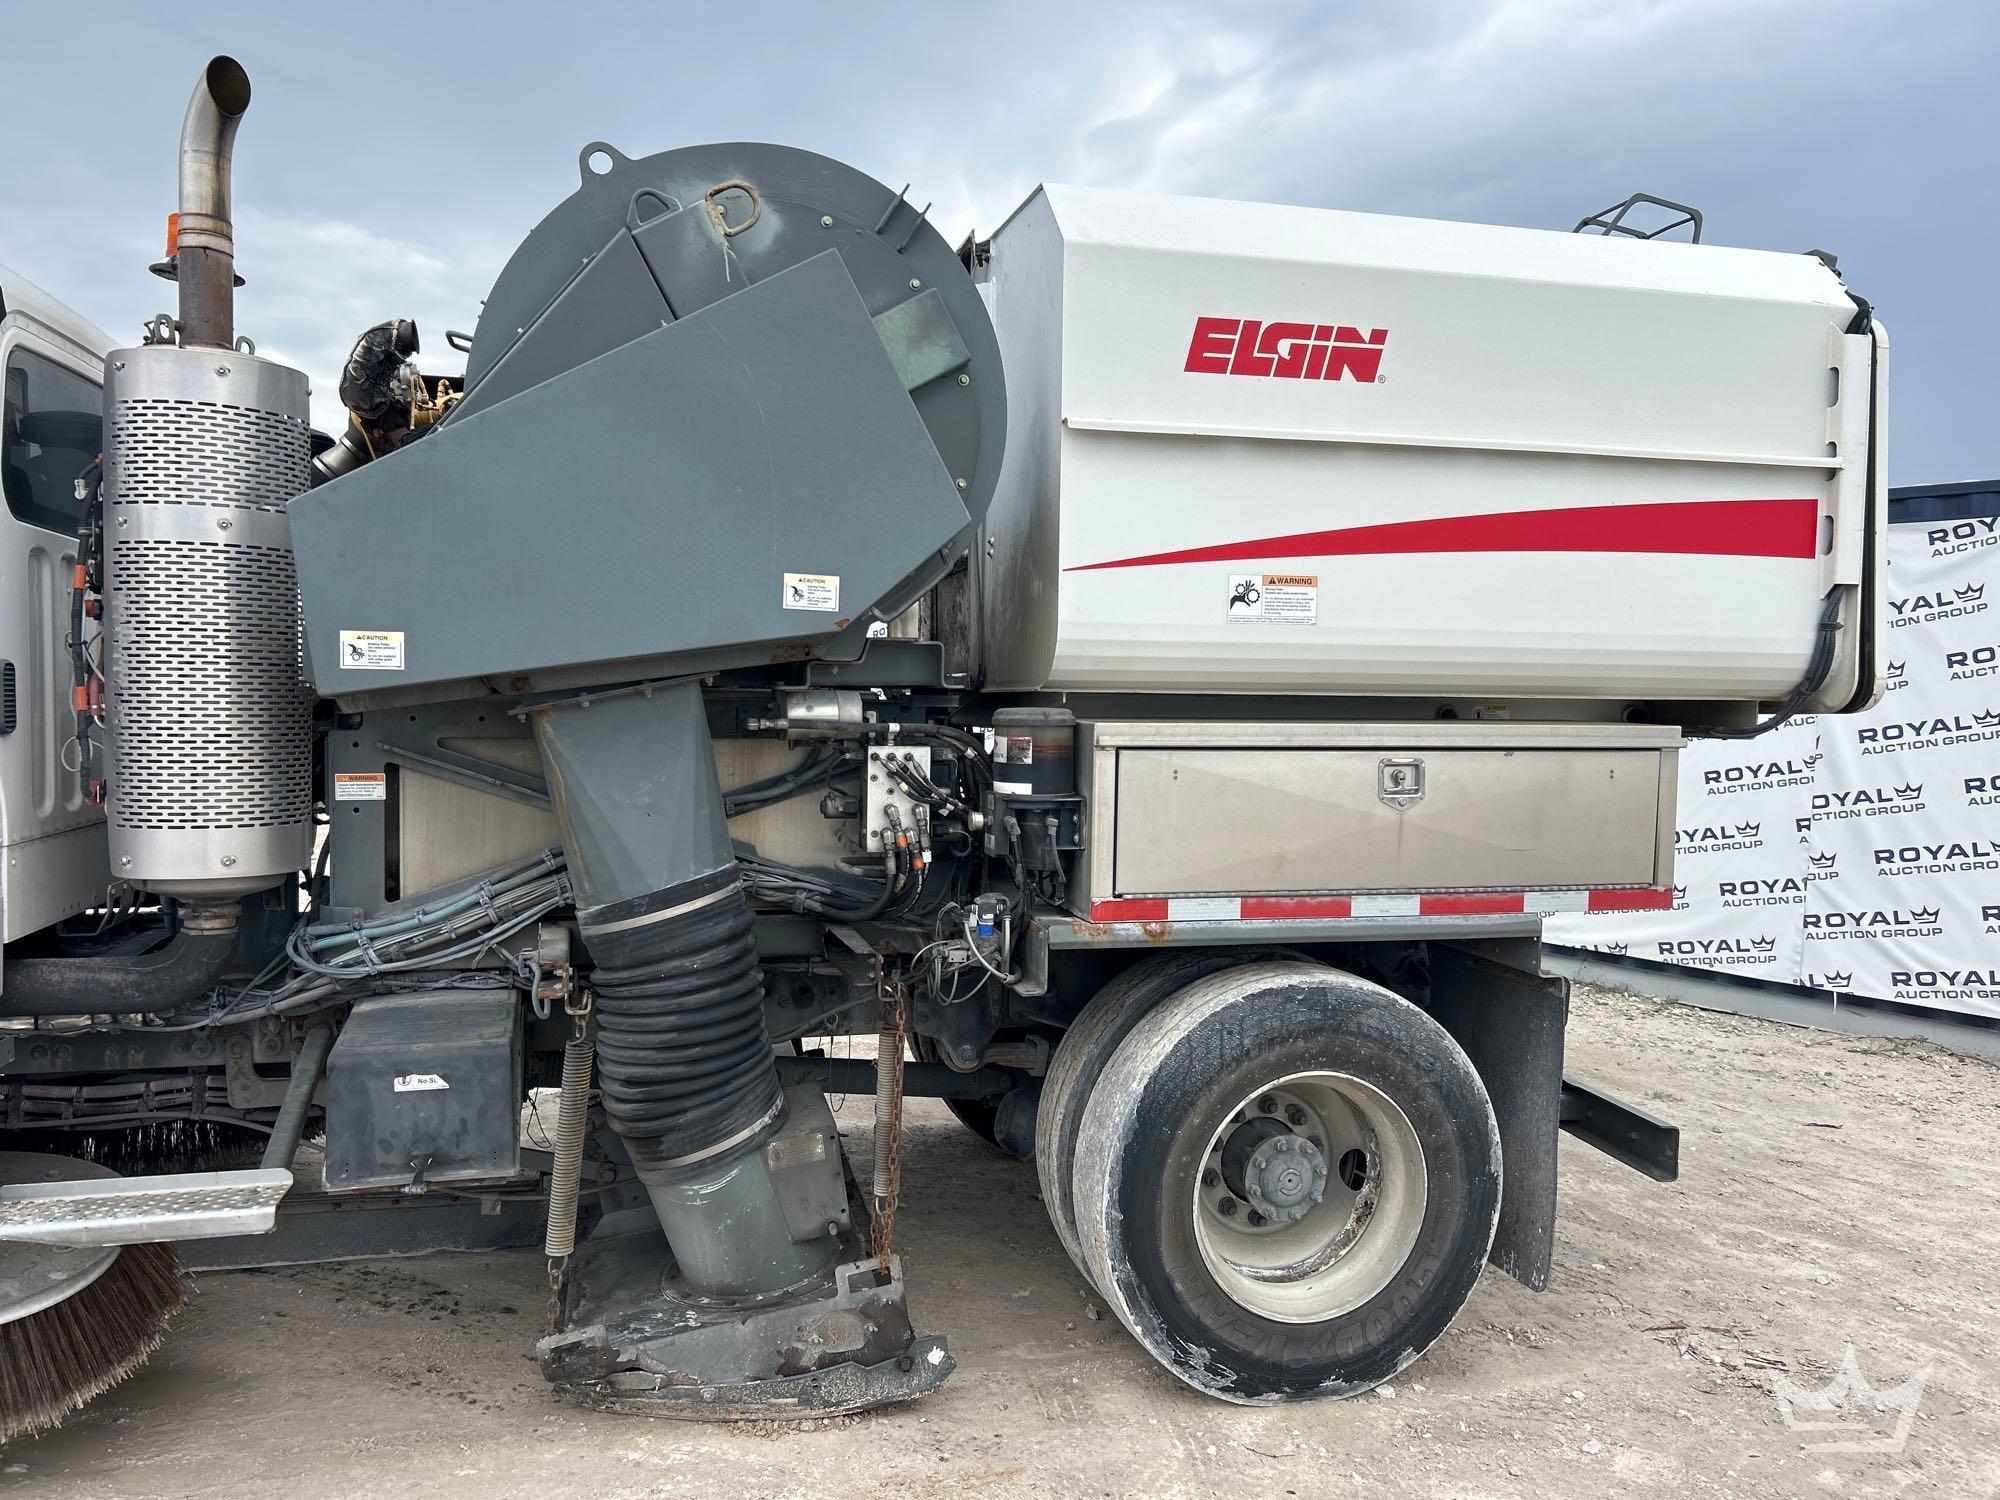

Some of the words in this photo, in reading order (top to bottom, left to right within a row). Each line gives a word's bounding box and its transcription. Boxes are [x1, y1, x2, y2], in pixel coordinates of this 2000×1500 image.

[1184, 316, 1389, 383] ELGIN
[1927, 515, 2000, 546] ROY
[1931, 534, 2000, 558] AUCTIO
[1276, 577, 1313, 585] WARNING
[1888, 591, 1954, 615] YAL
[1924, 602, 1988, 622] GROUP
[1950, 665, 2000, 681] AUCT
[1858, 715, 1973, 744] ROYAL
[1861, 738, 1939, 756] AUCTION
[1703, 760, 1803, 785] ROYAL
[1707, 780, 1774, 796] AUCTION
[1776, 775, 1815, 788] GRO
[1812, 788, 1894, 809] OYAL
[1812, 809, 1862, 822] CTION
[1865, 802, 1926, 817] GROUP
[1675, 825, 1736, 844] YAL
[1675, 844, 1709, 856] TION
[1711, 839, 1763, 852] GROUP
[1873, 841, 1991, 865] ROYAL
[1807, 871, 1840, 881] OUP
[1877, 863, 1956, 877] AUCTION
[1959, 860, 2000, 871] GRO
[1722, 896, 1790, 908] AUCTION
[1802, 910, 1911, 929] ROYAL
[1805, 930, 1878, 941] AUCTION
[1881, 927, 1943, 938] GROUP
[1657, 938, 1751, 955] ROYAL
[1662, 957, 1723, 966] AUCTION
[1726, 955, 1777, 964] GROUP
[1893, 989, 1974, 999] AUCTION
